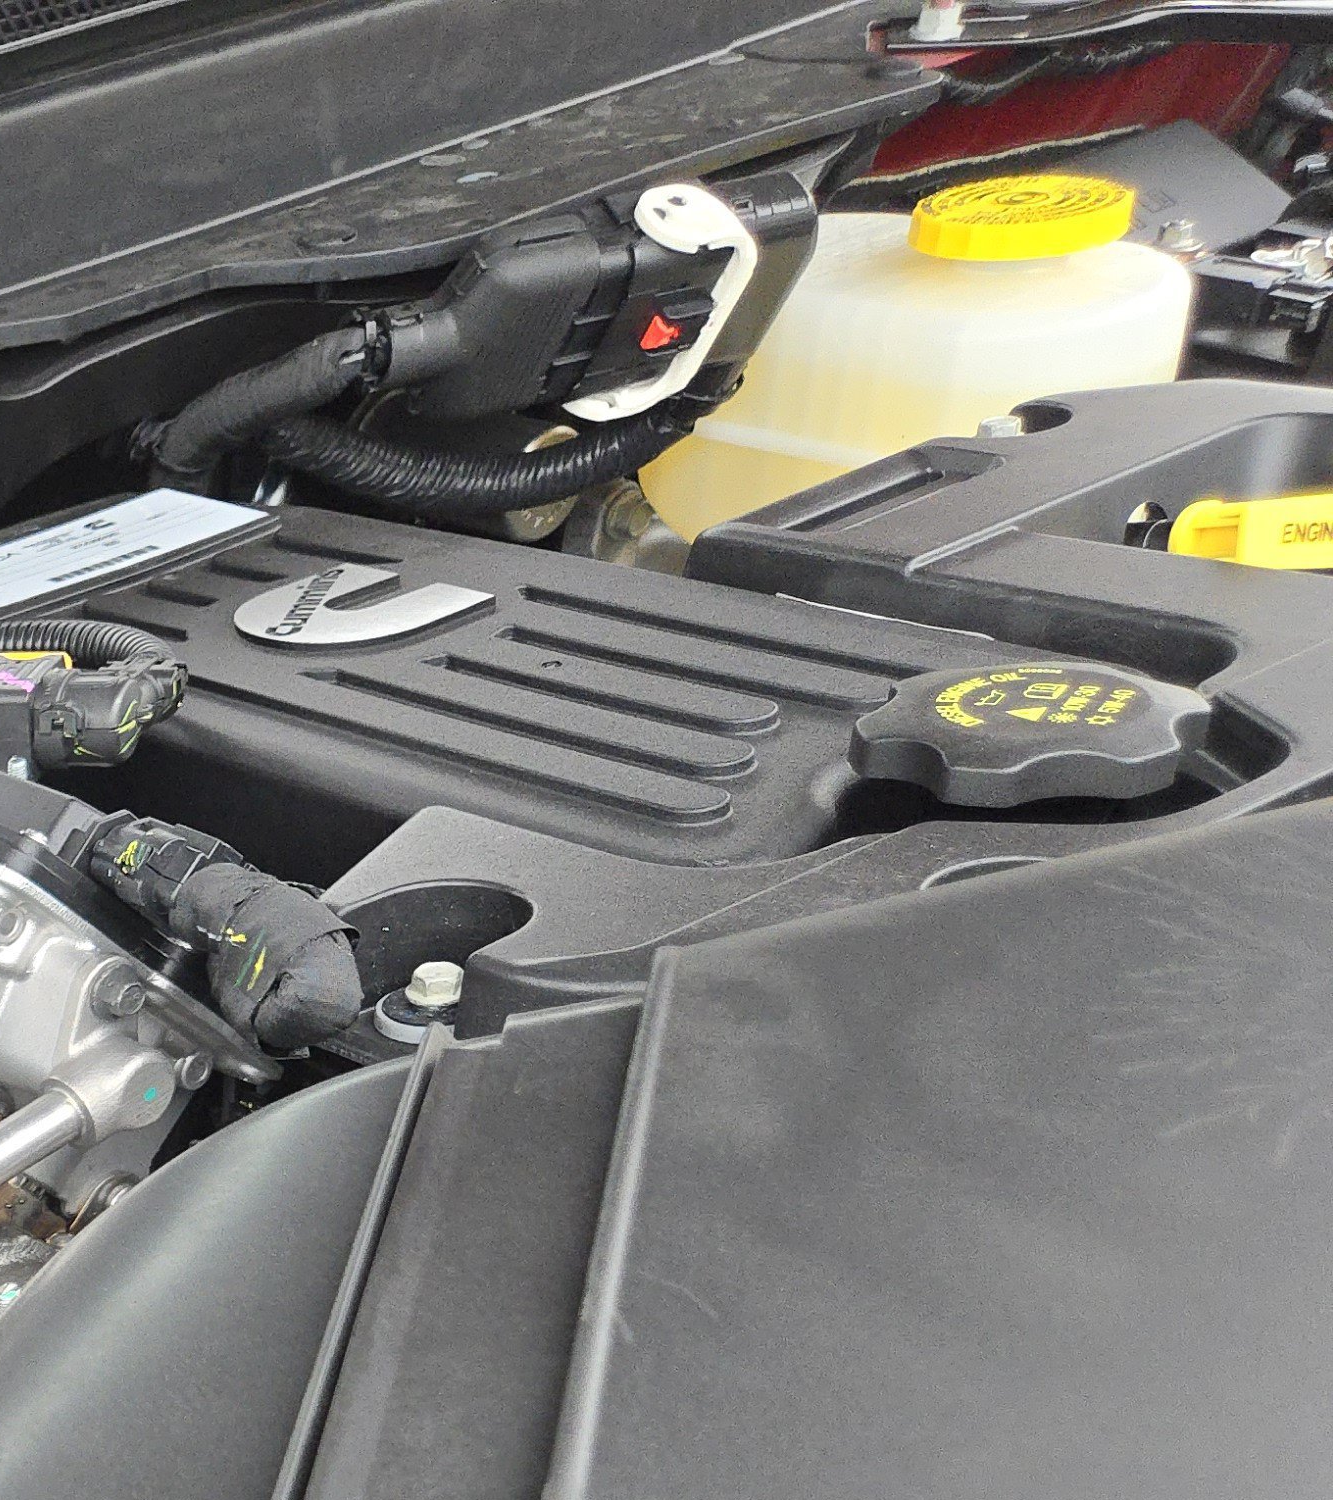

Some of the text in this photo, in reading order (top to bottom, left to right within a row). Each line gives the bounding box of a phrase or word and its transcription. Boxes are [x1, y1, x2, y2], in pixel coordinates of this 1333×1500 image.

[1282, 522, 1333, 544] ENGIN
[264, 568, 346, 636] Cummins
[935, 672, 1028, 728] DIESEL ENGINE OIL
[1060, 685, 1102, 712] 10W-30
[1097, 689, 1137, 714] 5W-40
